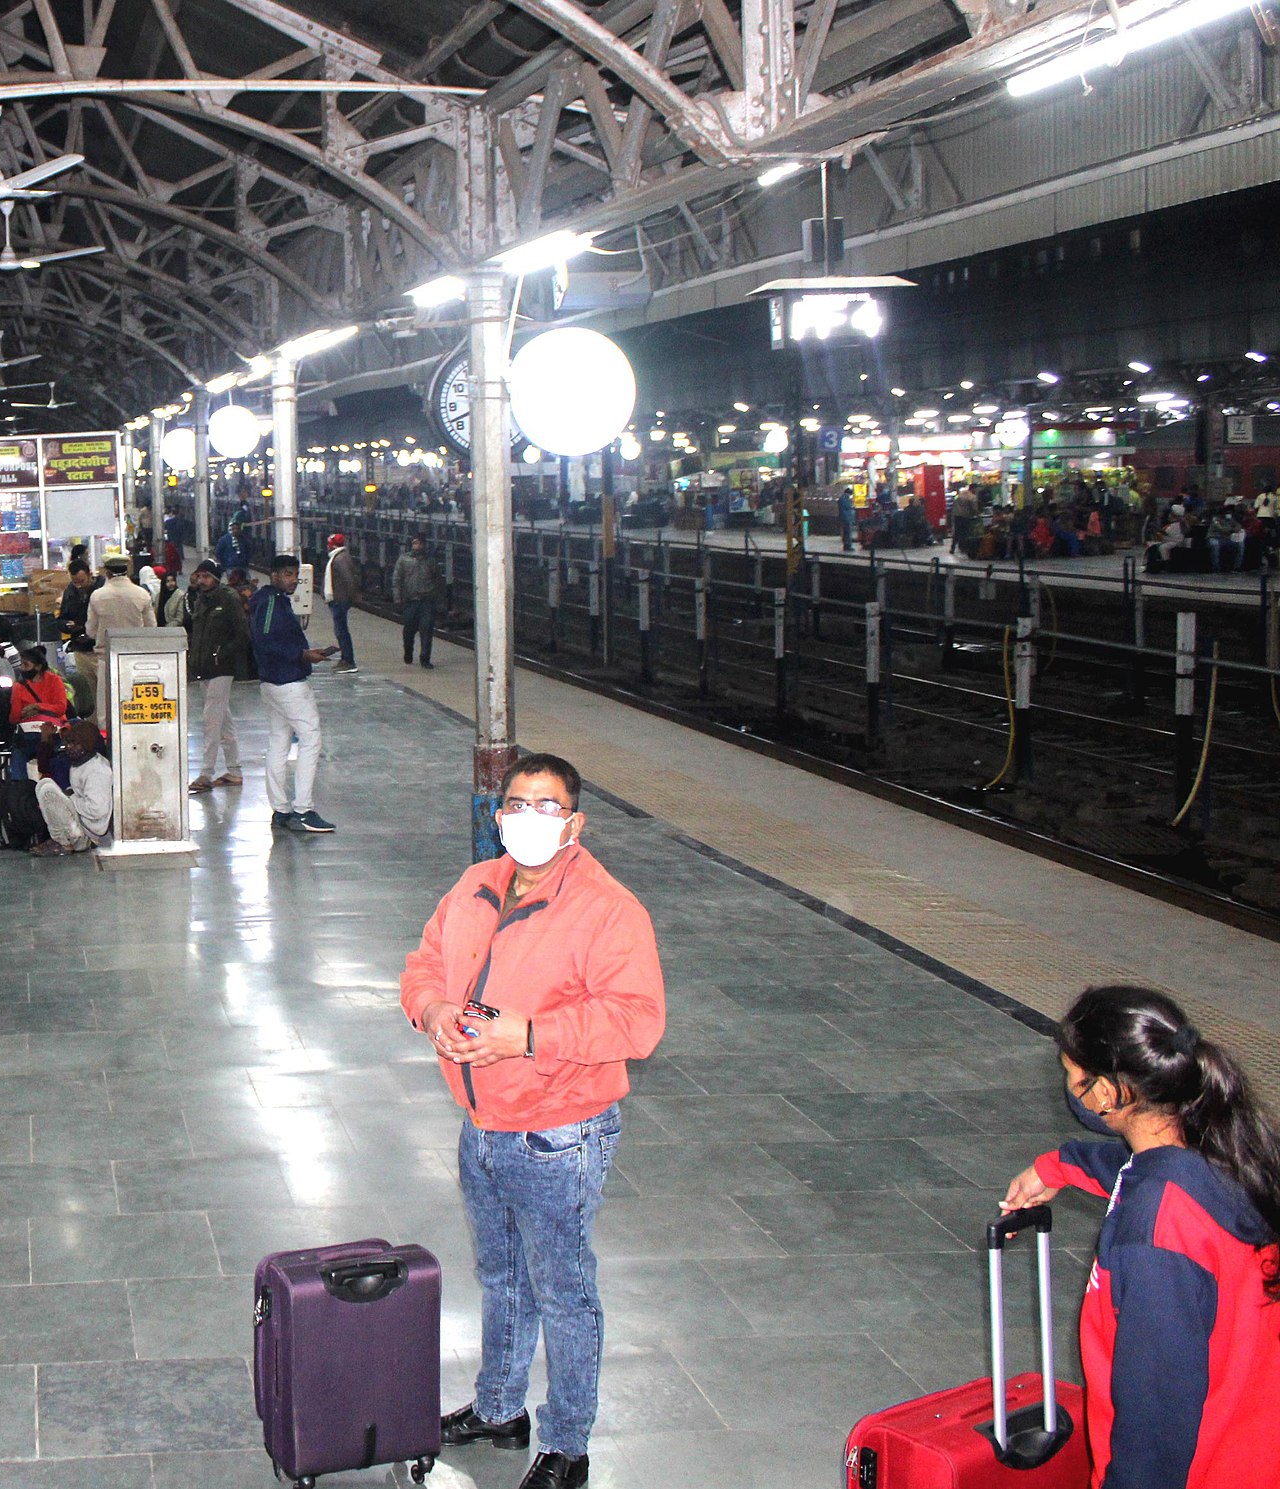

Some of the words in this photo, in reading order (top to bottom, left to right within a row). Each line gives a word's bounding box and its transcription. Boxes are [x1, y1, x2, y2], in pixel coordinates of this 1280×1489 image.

[453, 383, 465, 393] 10
[448, 402, 457, 412] 9
[456, 420, 465, 430] 8
[824, 430, 839, 448] 3
[0, 461, 37, 472] PURPOSE
[136, 687, 159, 698] L-59
